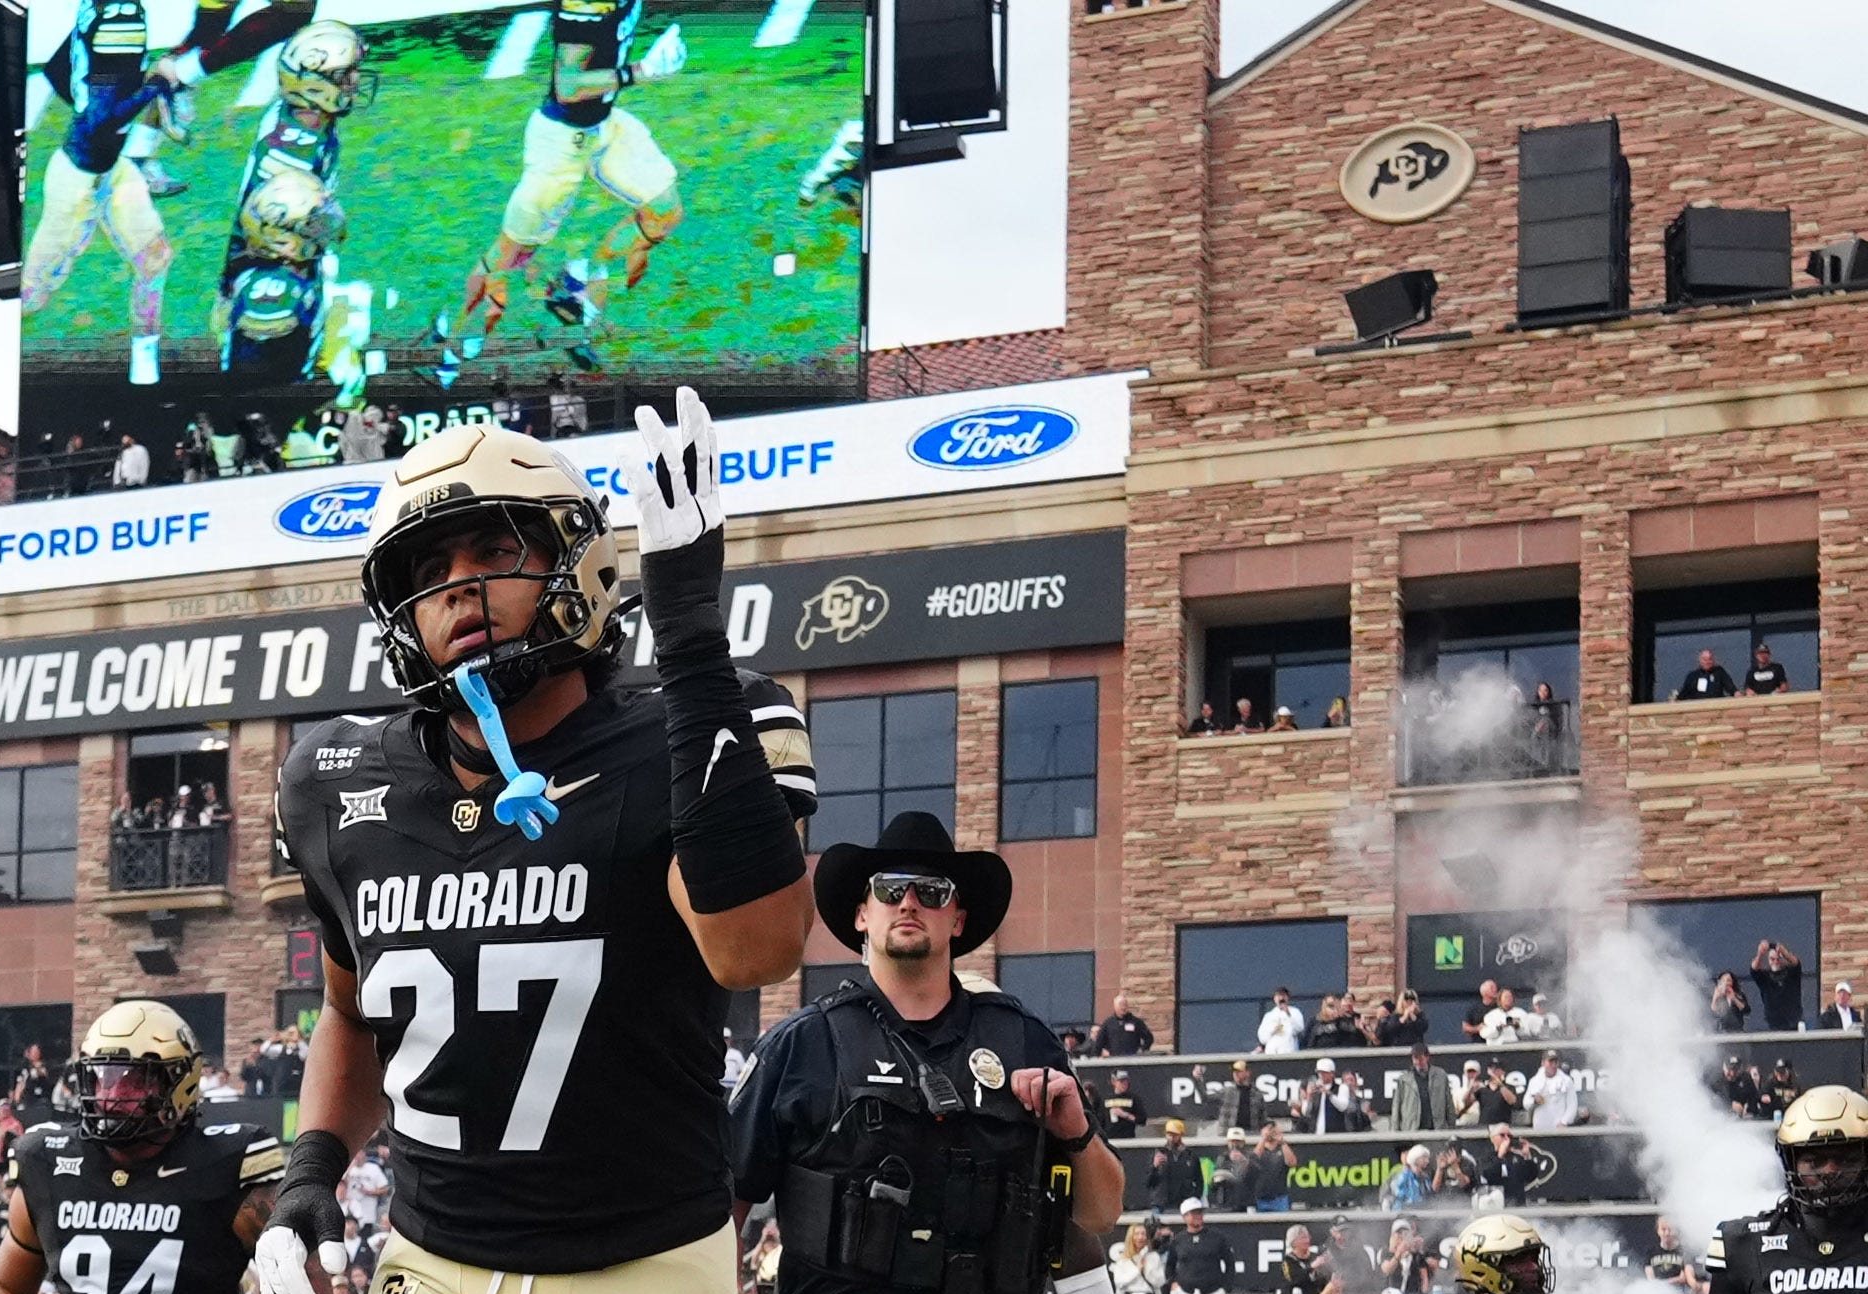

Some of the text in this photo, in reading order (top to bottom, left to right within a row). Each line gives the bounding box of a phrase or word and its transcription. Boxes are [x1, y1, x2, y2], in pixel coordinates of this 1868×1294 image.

[939, 415, 1045, 460] Ford
[719, 440, 834, 484] BUFF
[410, 484, 451, 512] BUFFS
[112, 512, 211, 551] BUFF
[926, 574, 1067, 618] #GOBUFFS
[259, 627, 329, 700] TO
[316, 746, 362, 760] mac
[318, 758, 353, 771] 82-94
[357, 863, 588, 937] COLORADO
[361, 938, 604, 1151] 27
[57, 1200, 181, 1233] COLORADO
[1770, 1266, 1868, 1294] COLORAD
